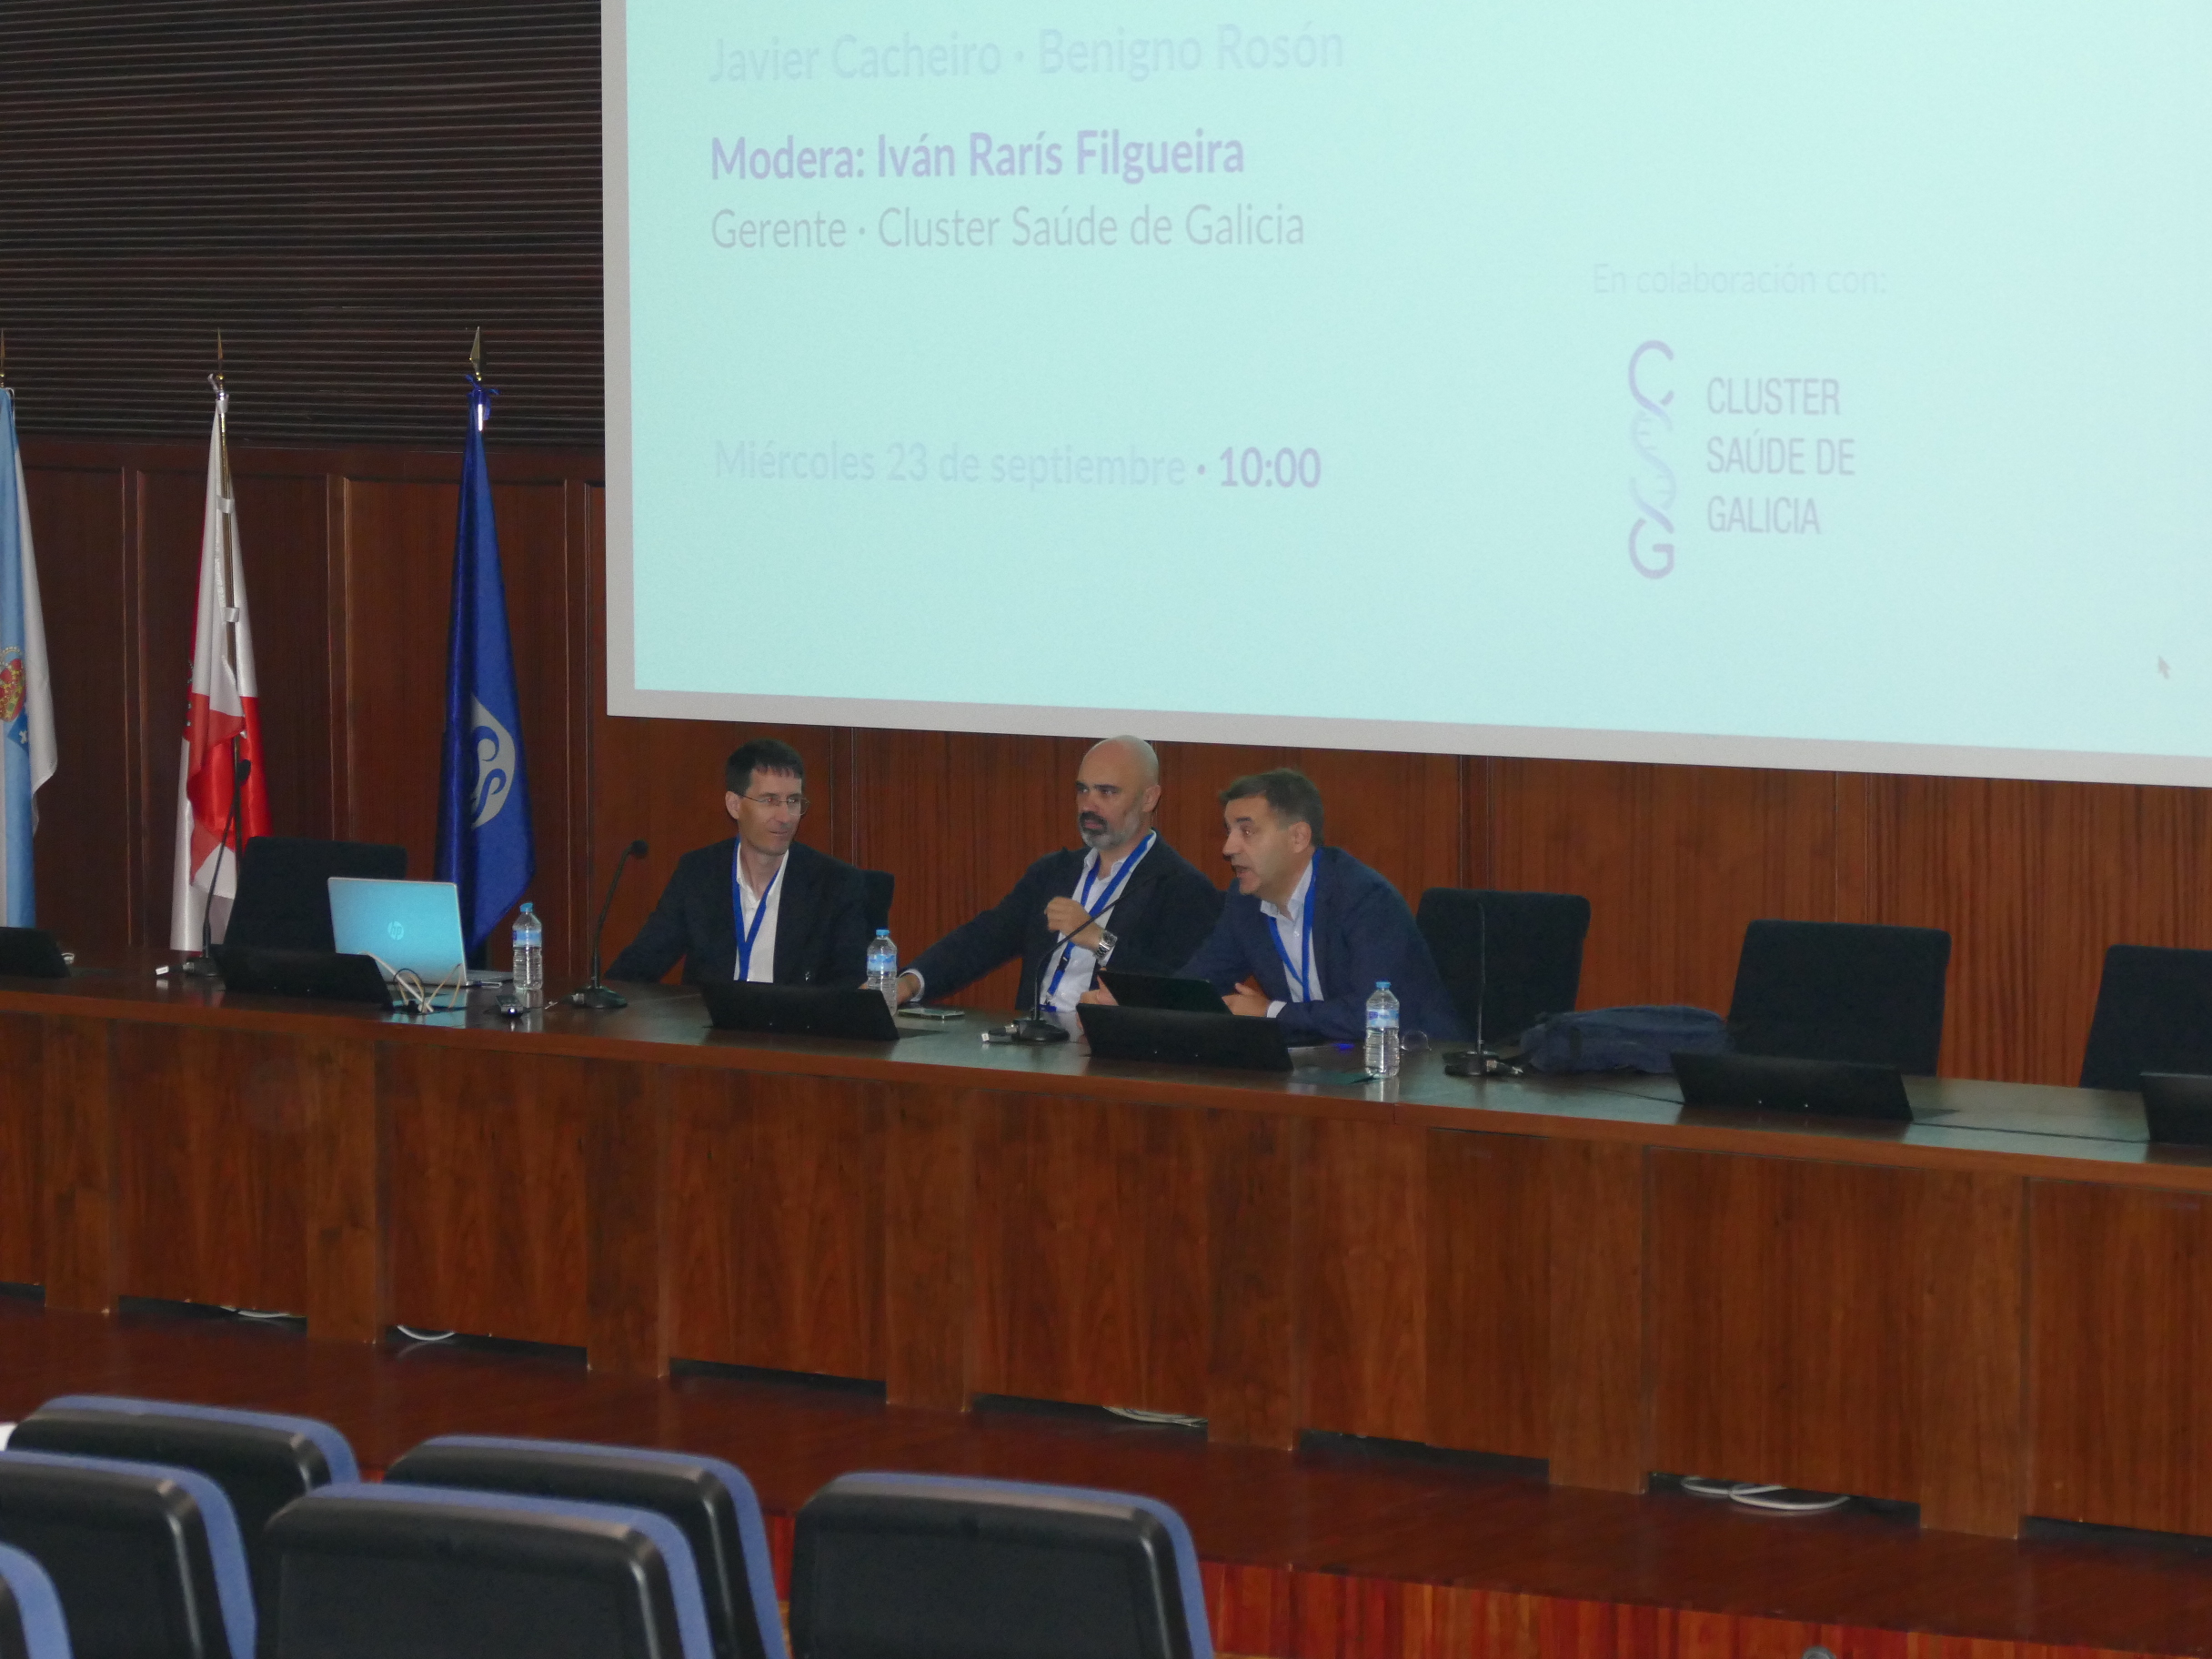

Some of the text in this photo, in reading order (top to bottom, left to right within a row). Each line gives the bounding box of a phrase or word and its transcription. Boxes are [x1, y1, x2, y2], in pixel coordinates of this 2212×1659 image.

[709, 35, 821, 84] Javier
[830, 30, 1002, 80] Cacheiro
[1039, 25, 1203, 83] Benigno
[1217, 21, 1344, 70] Rosón
[711, 127, 1245, 185] Modera: Iván Rarís Filgueira
[710, 207, 848, 250] Gerente
[877, 206, 1001, 248] Cluster
[1011, 205, 1119, 247] Saúde
[1129, 203, 1173, 246] de
[1184, 202, 1305, 246] Galicia
[1593, 261, 1888, 295] En colaboración con:
[1706, 376, 1841, 416] CLUSTER
[715, 439, 877, 482] Miércoles
[886, 440, 930, 483] 23
[939, 441, 981, 484] de
[990, 443, 1186, 493] septiembre
[1219, 446, 1322, 489] 10:00
[1705, 428, 1855, 477] SAÚDE DE
[1706, 494, 1823, 536] GALICIA
